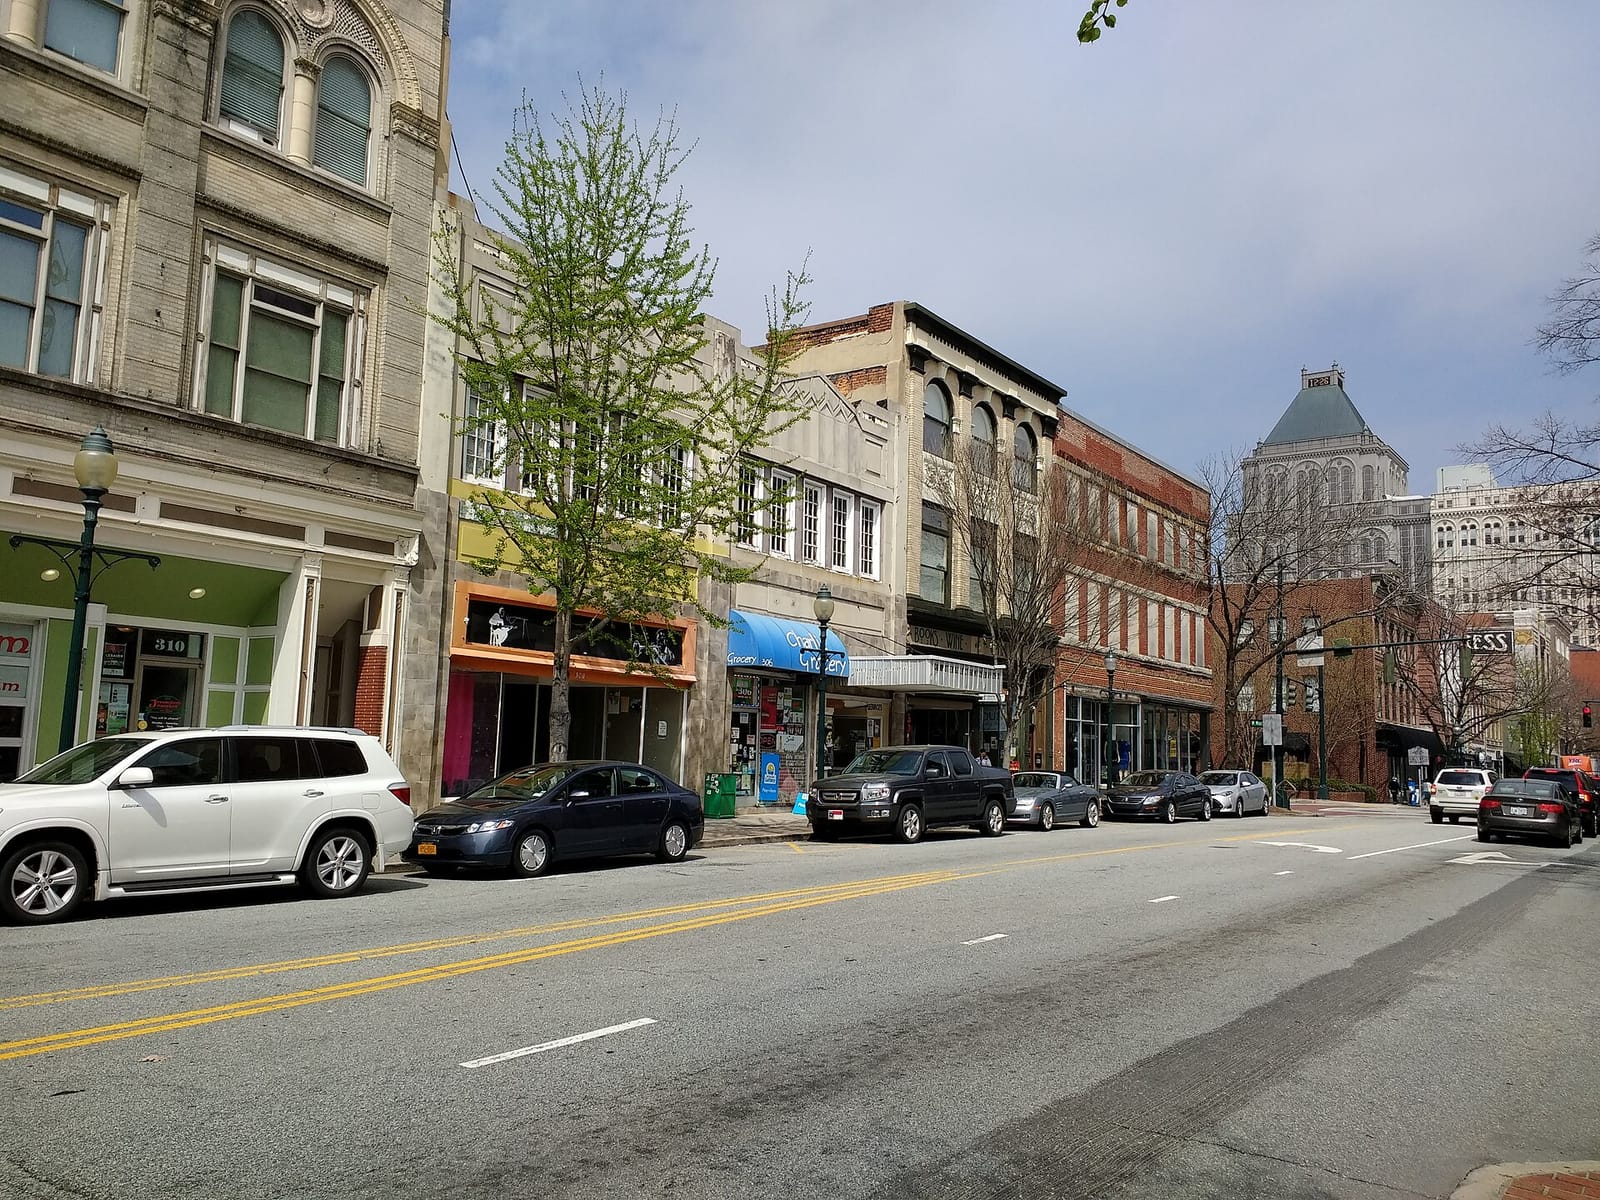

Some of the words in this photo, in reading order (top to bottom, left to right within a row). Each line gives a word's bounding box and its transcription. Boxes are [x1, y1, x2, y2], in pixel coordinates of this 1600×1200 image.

[154, 638, 184, 652] 310
[727, 652, 757, 665] Grocery
[761, 658, 774, 667] 306
